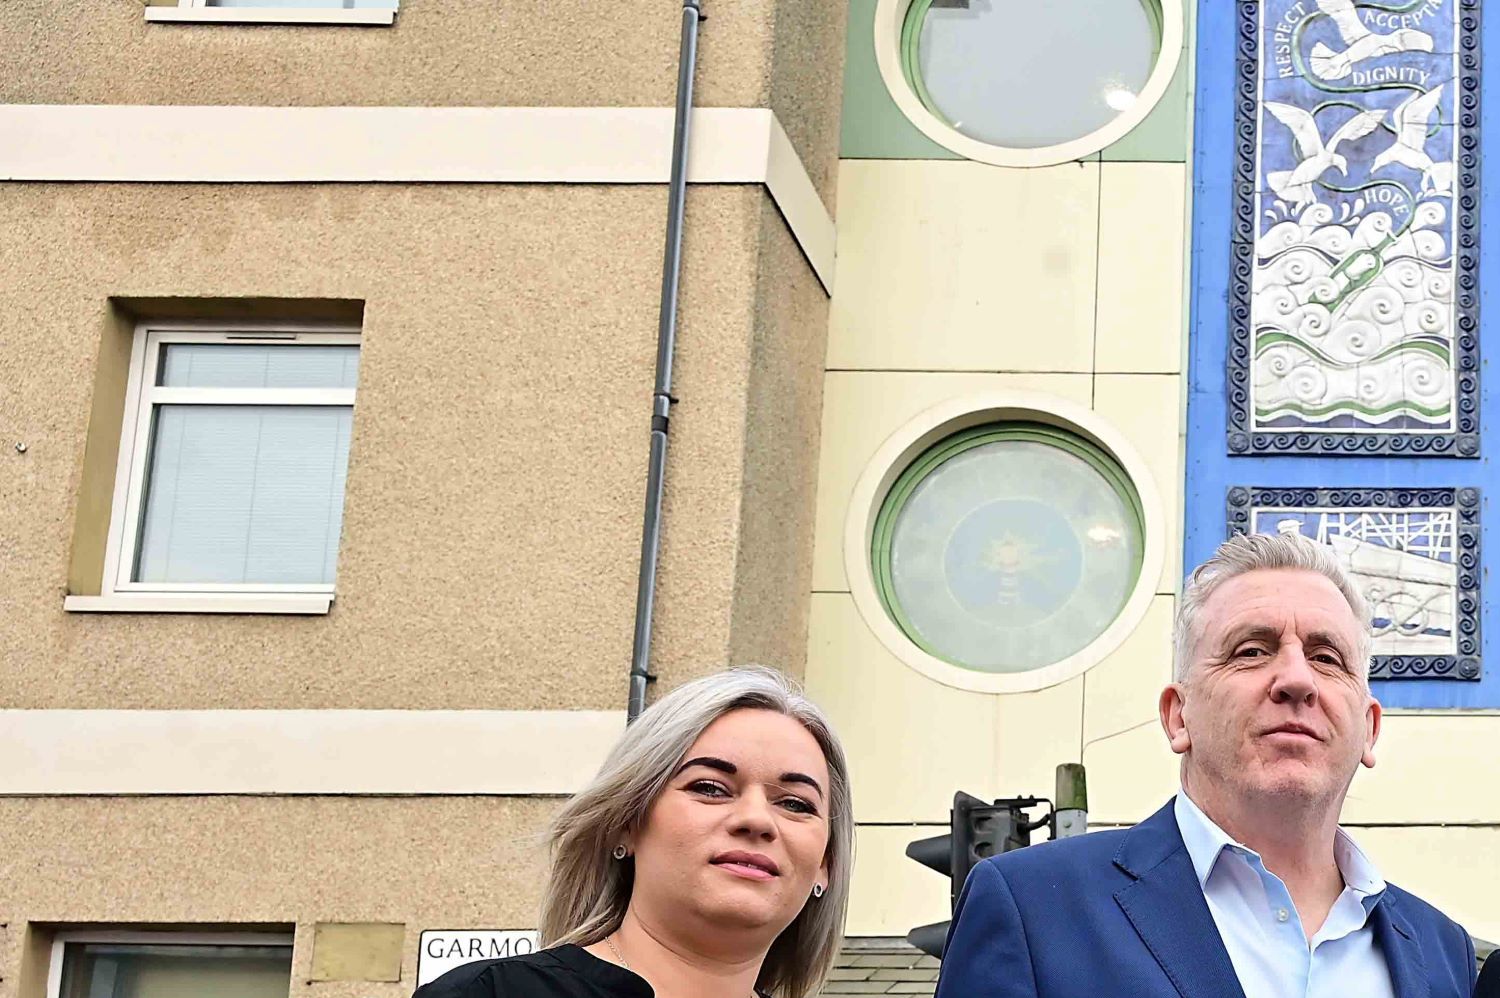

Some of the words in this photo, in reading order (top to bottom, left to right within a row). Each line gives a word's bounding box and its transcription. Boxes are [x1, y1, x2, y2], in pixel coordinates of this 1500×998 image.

[1274, 2, 1306, 78] RESPECT
[1353, 67, 1430, 85] DIGNITY
[1364, 188, 1409, 216] HOPE
[427, 937, 533, 958] GARMO
